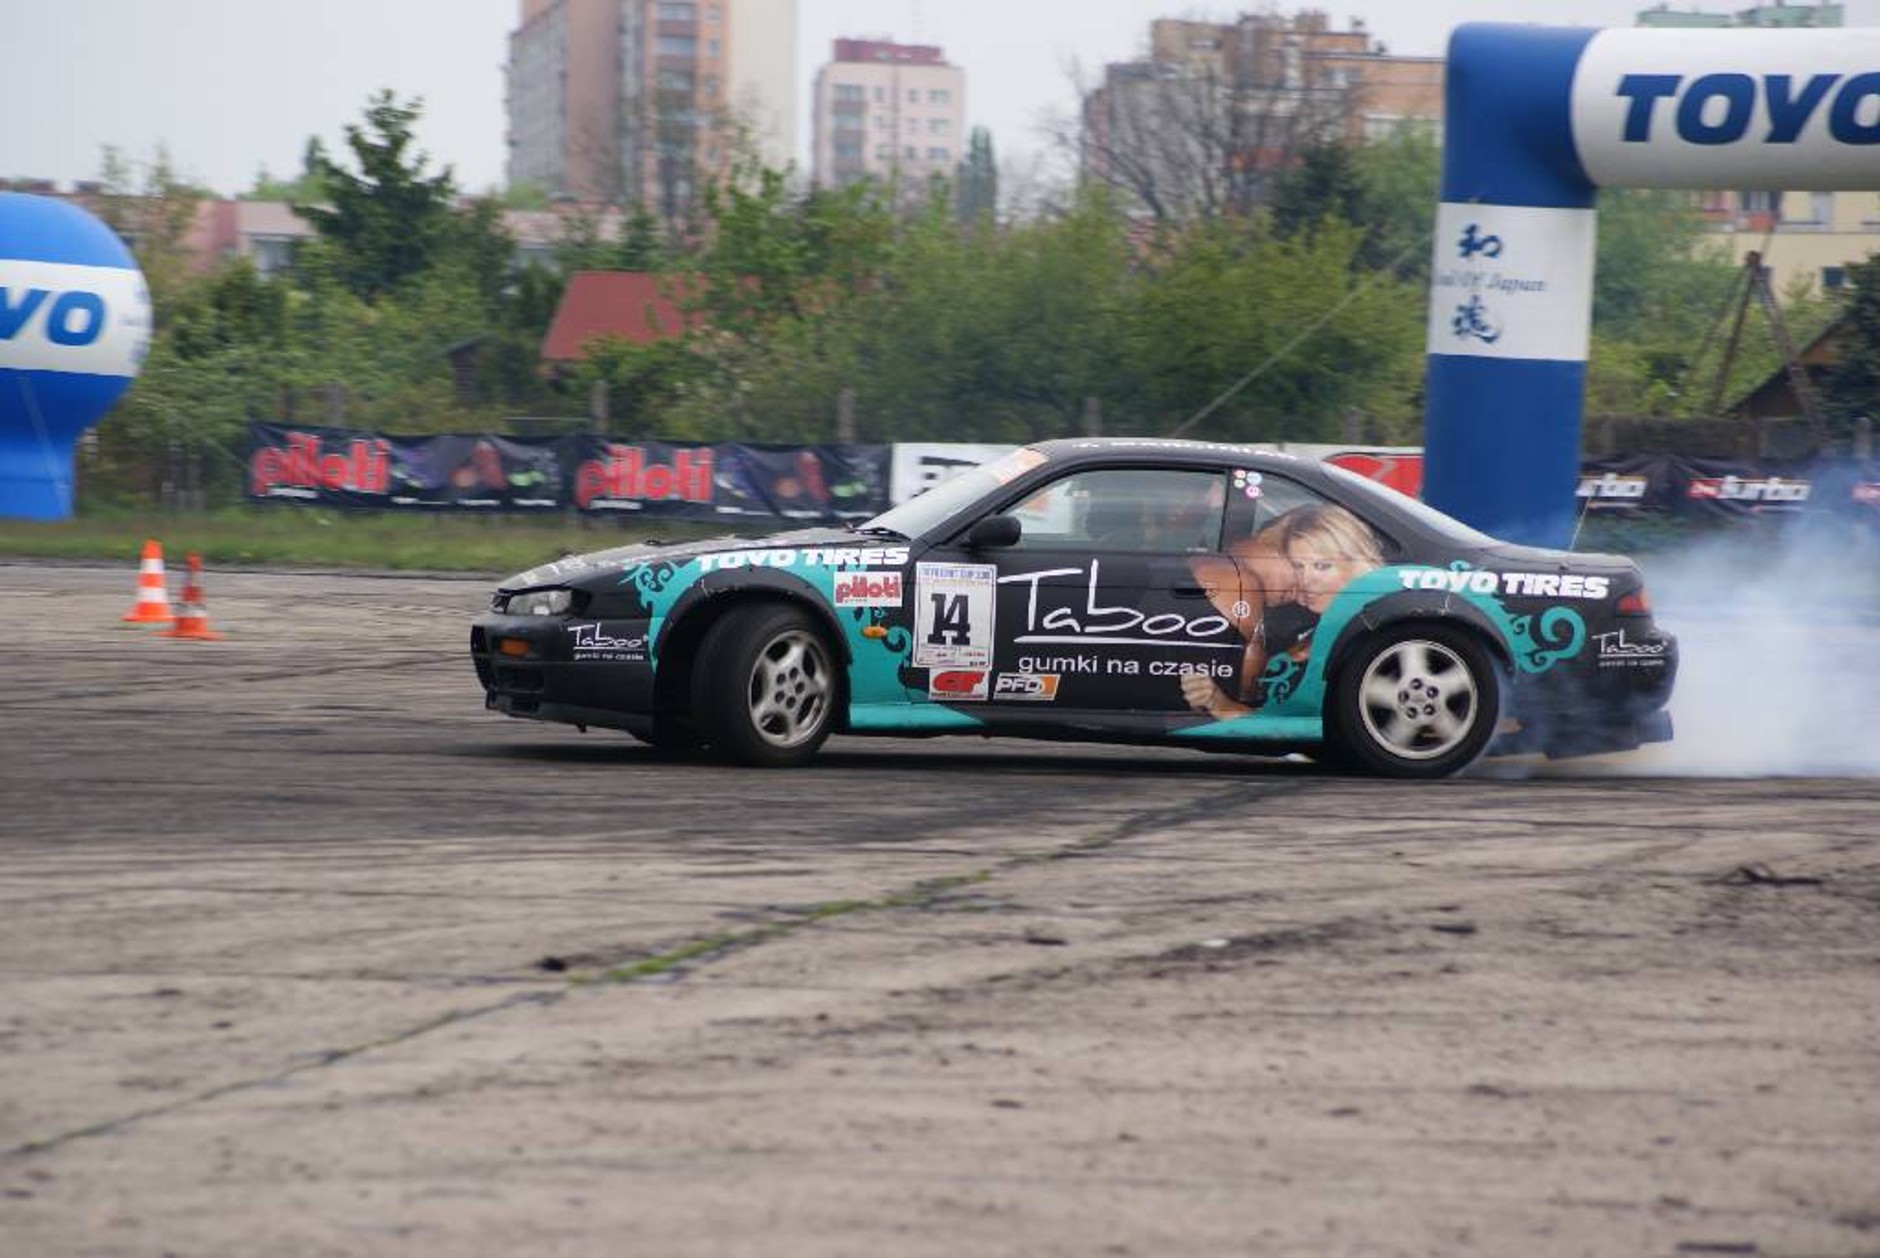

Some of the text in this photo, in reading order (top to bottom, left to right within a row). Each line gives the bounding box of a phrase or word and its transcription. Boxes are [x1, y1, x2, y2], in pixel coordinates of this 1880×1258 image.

[253, 432, 390, 496] piloti
[575, 443, 714, 508] piloti
[696, 549, 797, 571] TOYO
[802, 547, 910, 566] TIRES
[836, 575, 900, 603] piloti
[1399, 570, 1609, 599] TOYO TIRES
[928, 593, 970, 645] 14
[1018, 654, 1233, 678] gumki na czasie
